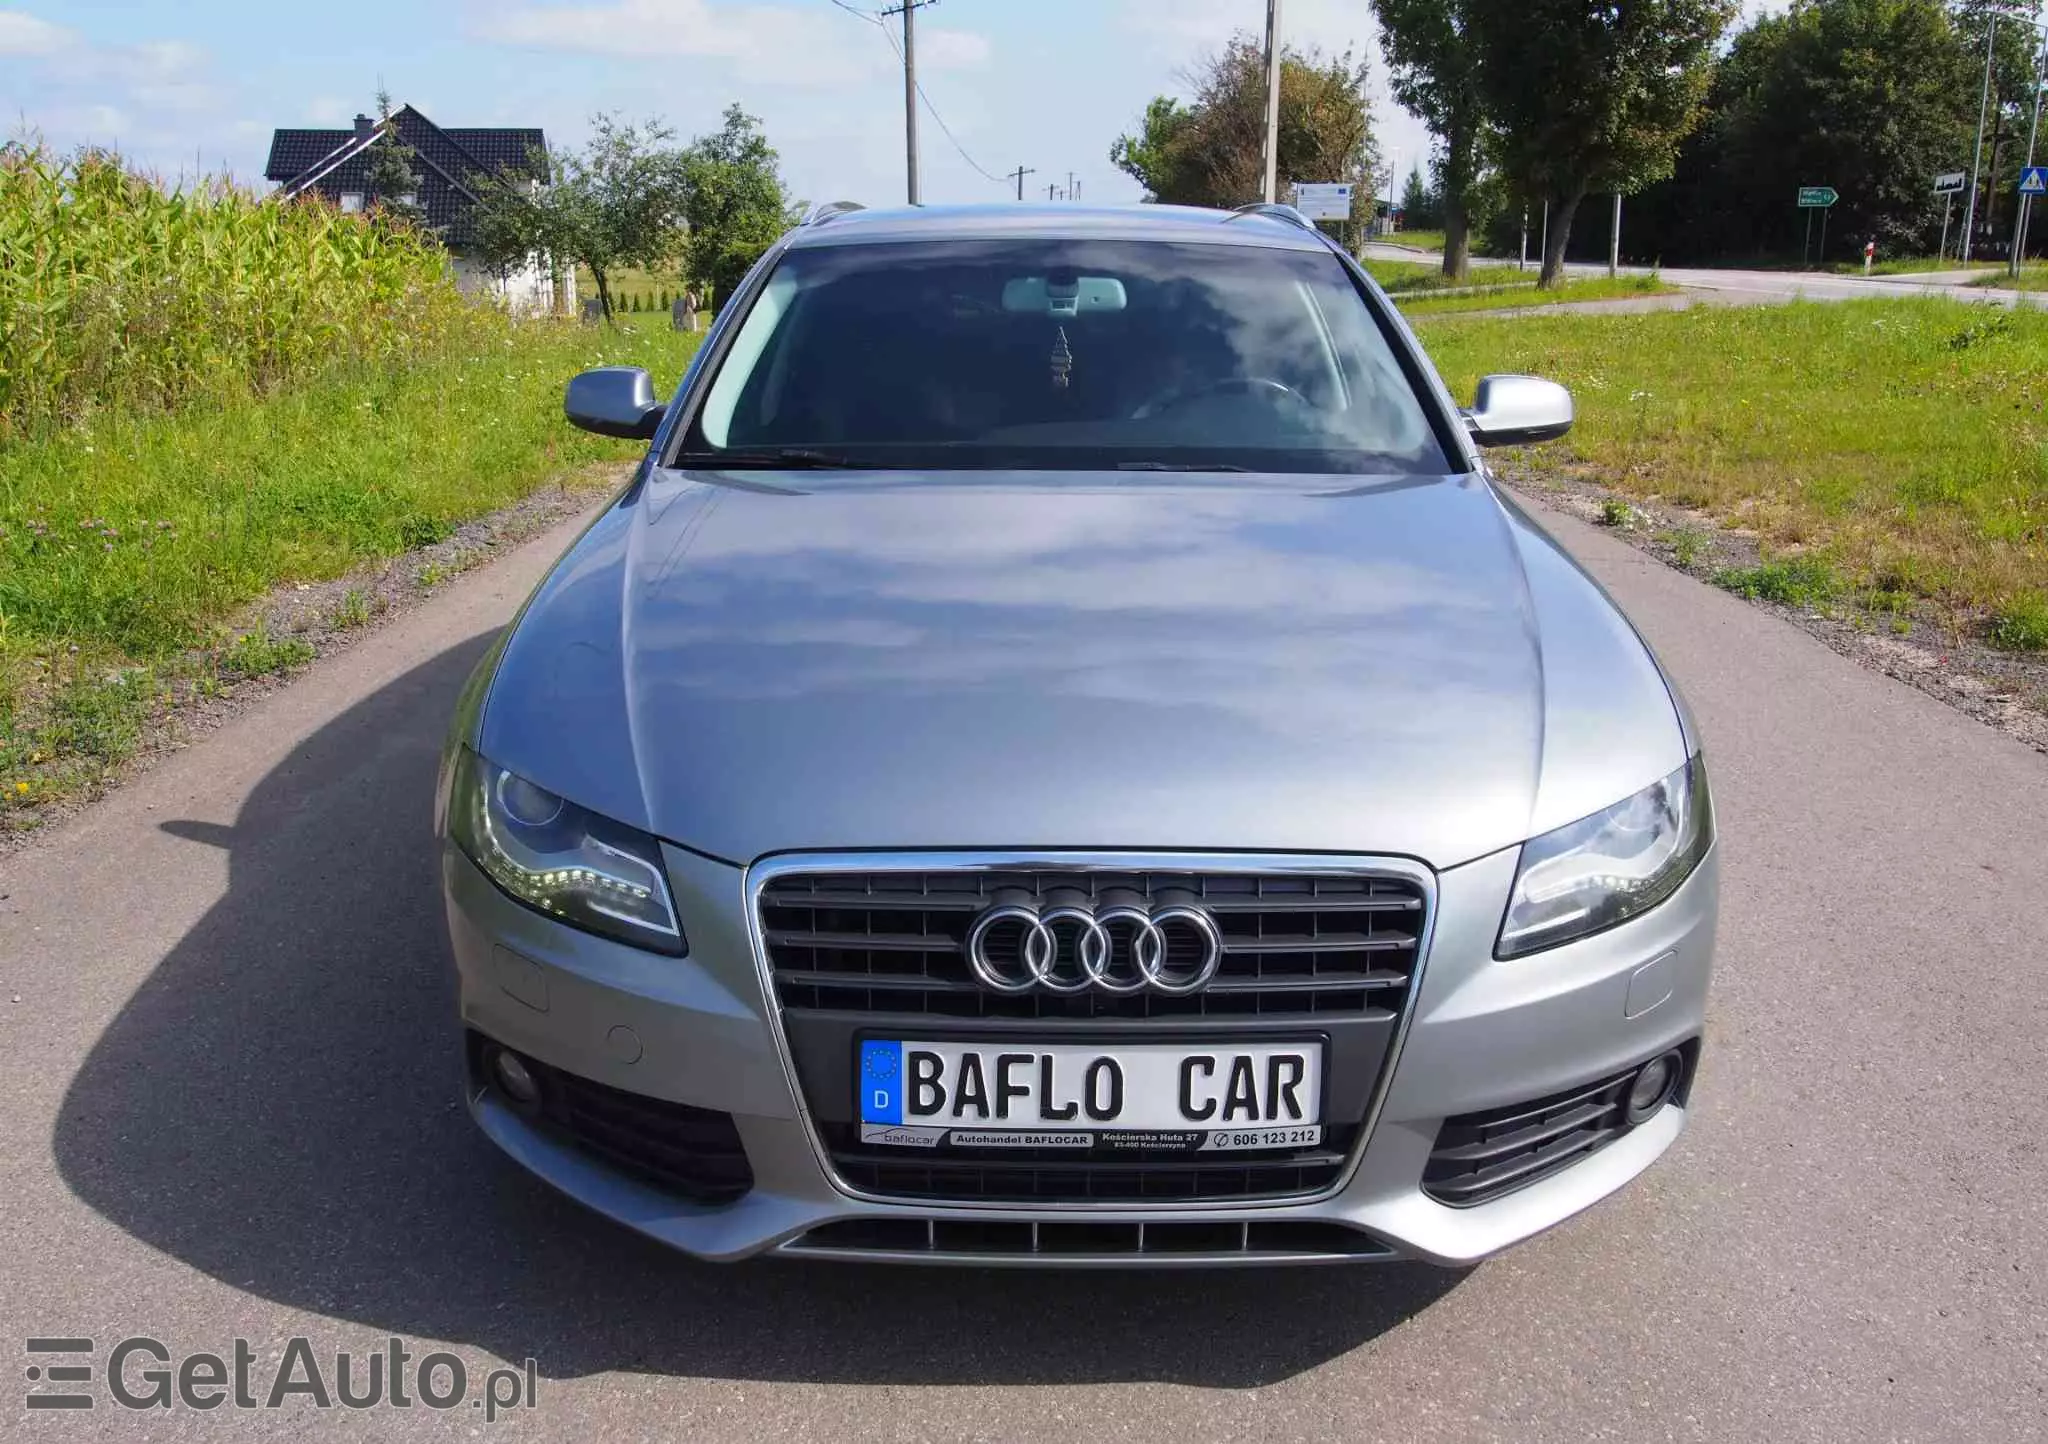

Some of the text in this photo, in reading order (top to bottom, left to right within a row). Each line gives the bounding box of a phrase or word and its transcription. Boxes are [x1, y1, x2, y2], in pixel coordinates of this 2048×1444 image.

[908, 1052, 1304, 1121] BAFLO CAR
[874, 1090, 889, 1108] D
[884, 1134, 935, 1145] baflocar
[956, 1135, 1088, 1145] Autohandel BAFLOCAR
[1160, 1133, 1183, 1141] Huta
[1234, 1130, 1314, 1146] 606 123 212
